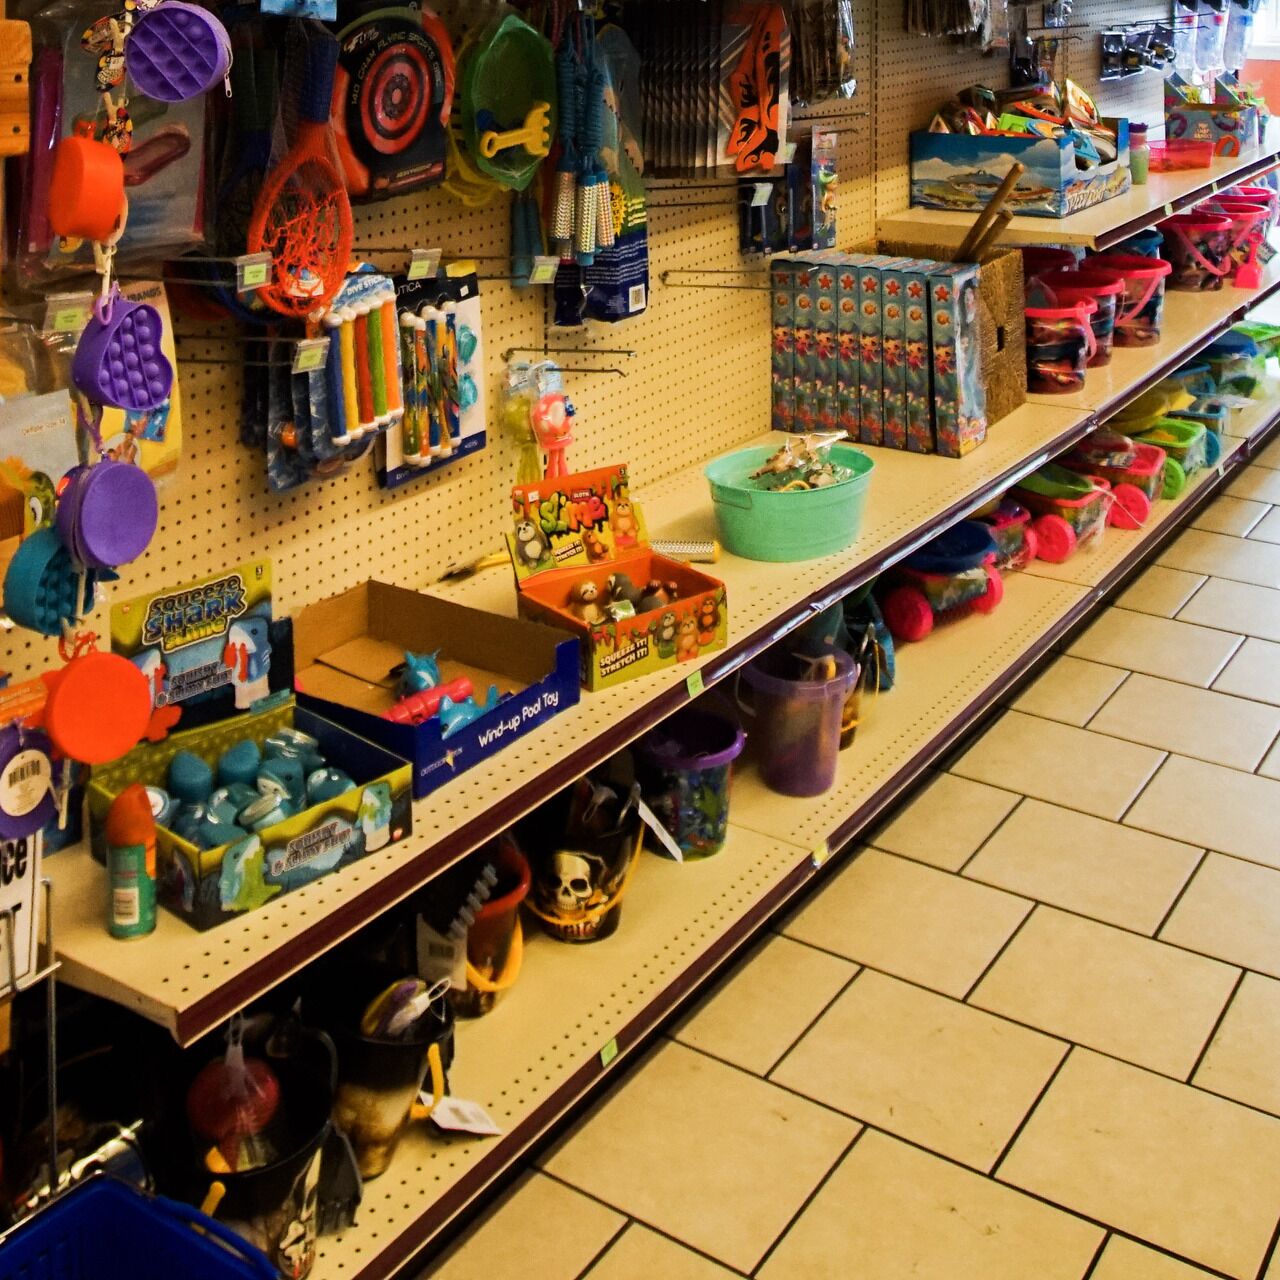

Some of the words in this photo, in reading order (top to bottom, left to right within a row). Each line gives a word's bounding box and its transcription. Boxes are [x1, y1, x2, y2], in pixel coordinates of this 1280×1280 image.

[600, 644, 635, 667] SQUEEZE
[635, 637, 648, 651] IT!
[601, 653, 637, 677] STRETCH
[636, 647, 649, 661] IT!
[478, 717, 521, 748] Wind-up
[522, 701, 542, 726] Pool
[542, 690, 559, 713] Toy
